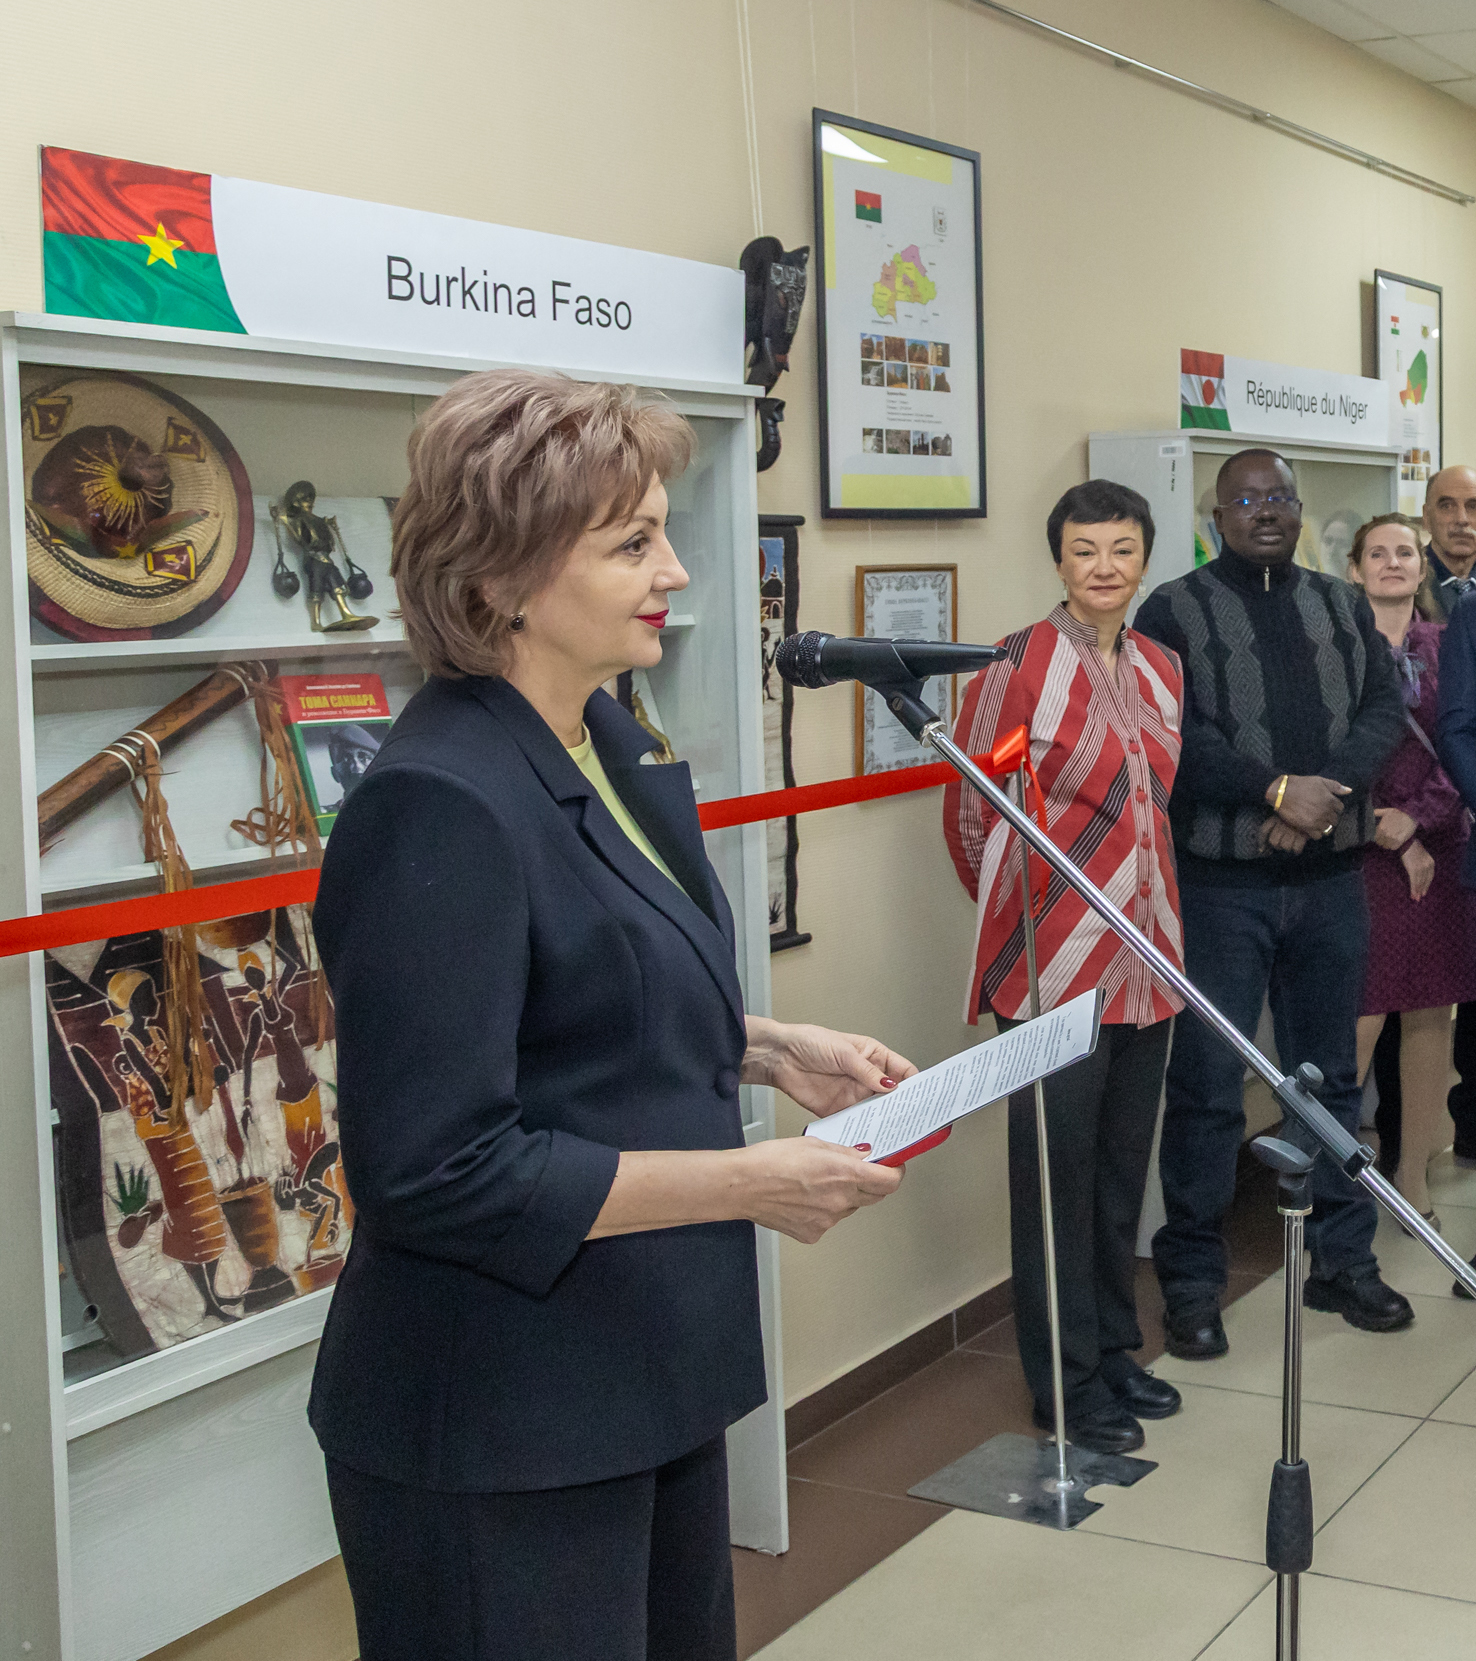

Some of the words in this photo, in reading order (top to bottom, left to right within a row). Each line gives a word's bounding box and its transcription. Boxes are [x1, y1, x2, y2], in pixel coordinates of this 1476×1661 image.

[387, 255, 537, 318] Burkina
[551, 280, 632, 330] Faso
[1246, 380, 1318, 418] République
[1321, 392, 1336, 415] du
[1339, 394, 1368, 425] Niger
[299, 696, 330, 709] ТОМА
[330, 694, 376, 707] САНКАРА
